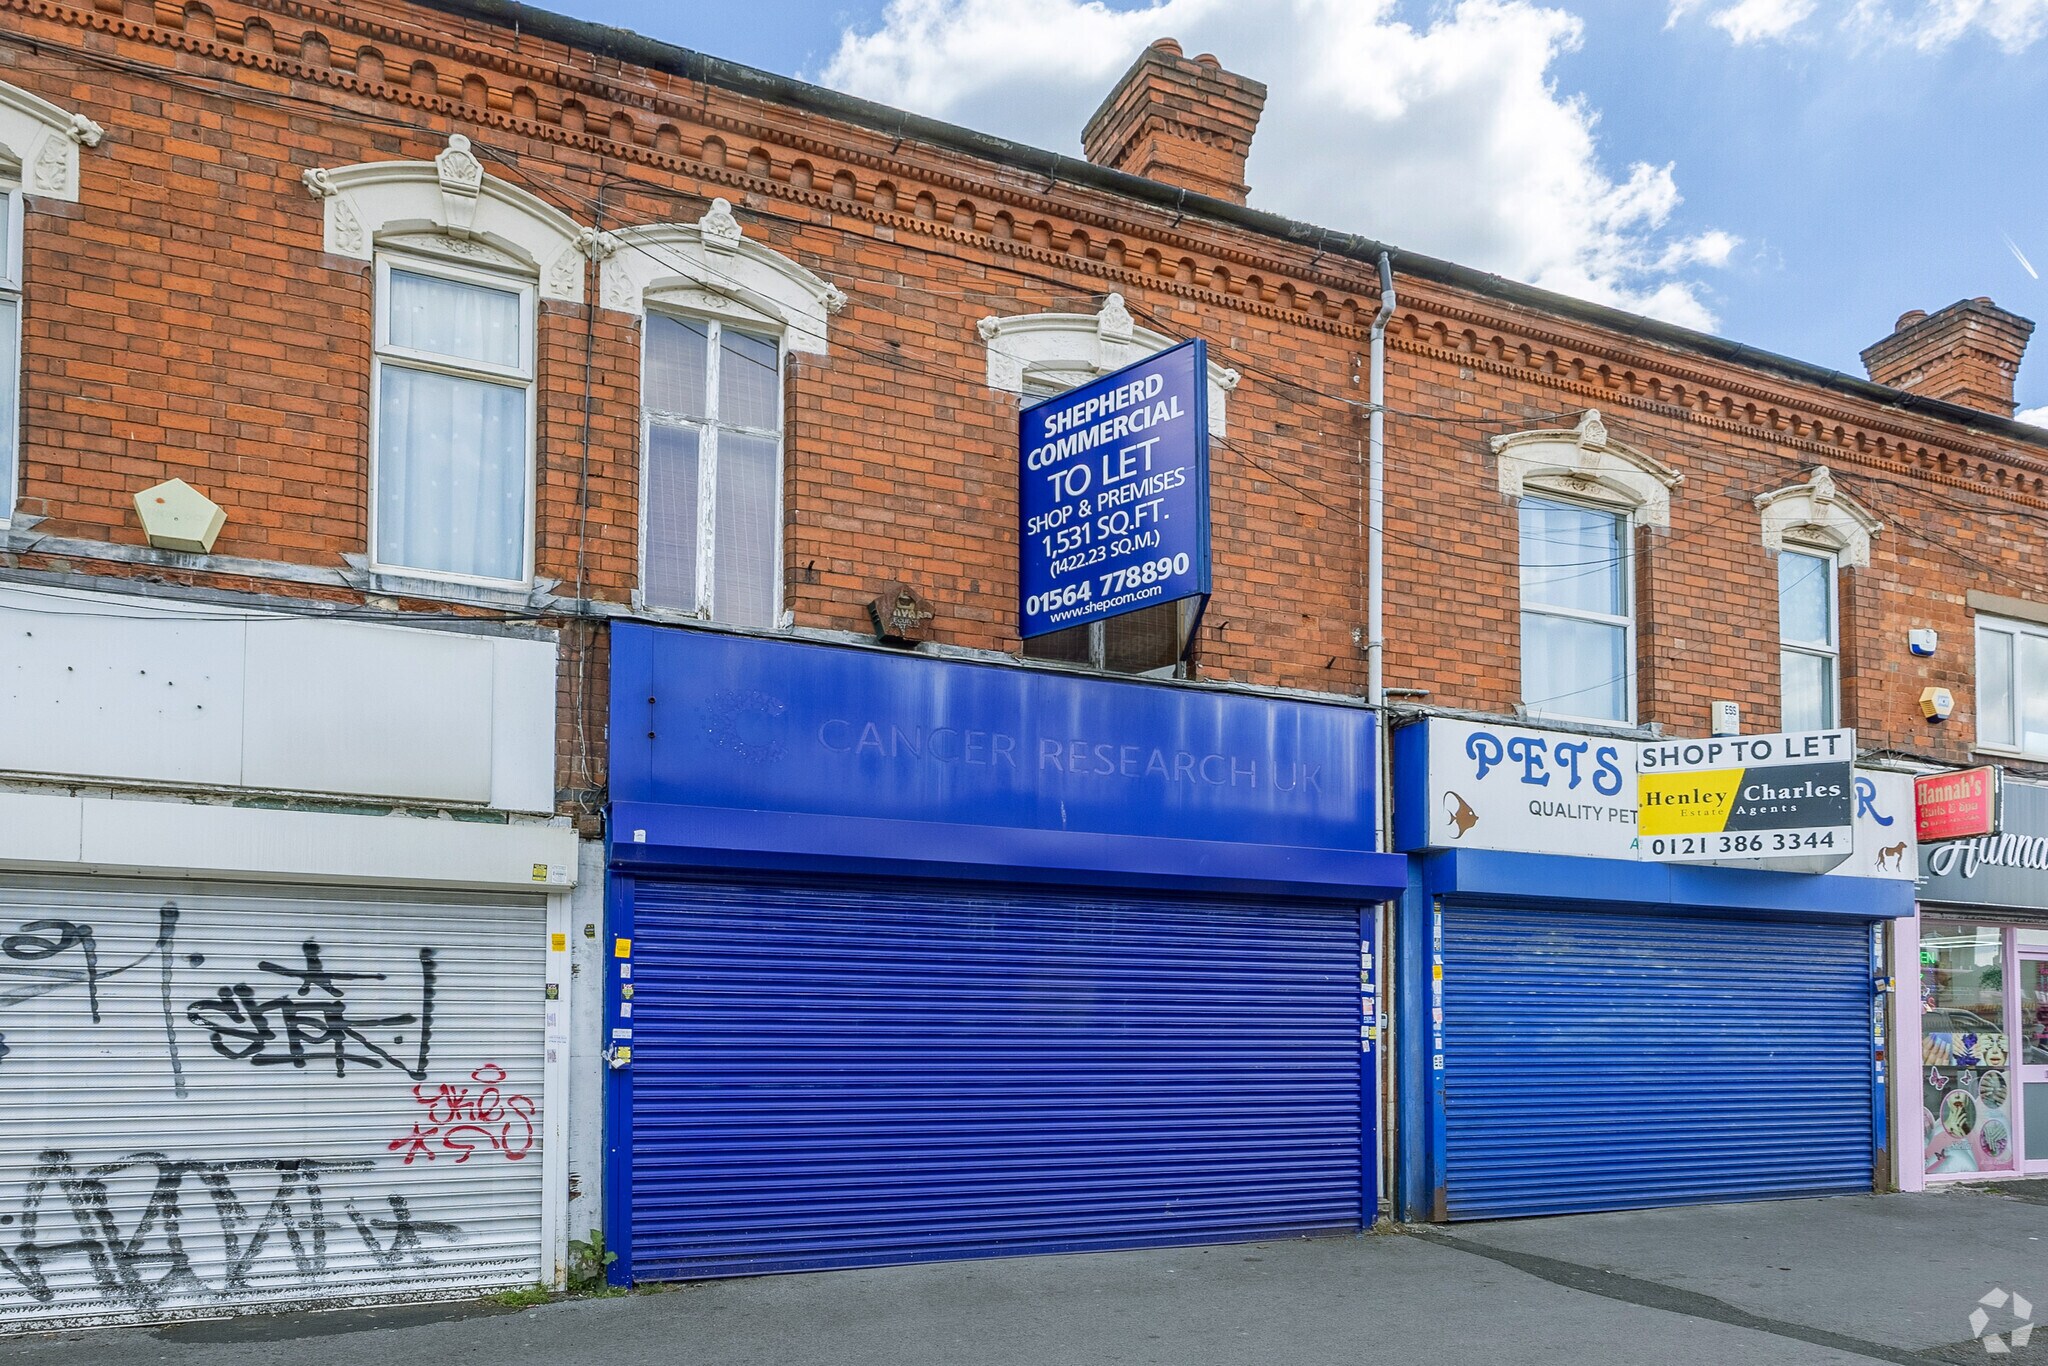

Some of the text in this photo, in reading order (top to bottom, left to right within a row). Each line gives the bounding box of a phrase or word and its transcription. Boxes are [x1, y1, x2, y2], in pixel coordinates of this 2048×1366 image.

[1044, 373, 1164, 439] SHEPHERD
[1027, 395, 1185, 471] COMMERCIAL
[1047, 436, 1161, 503] TO LET
[1027, 467, 1186, 536] SHOP & PREMISES
[1042, 497, 1170, 559] 1,531 SQ.FT.
[1050, 529, 1161, 579] (1422.23 SQ.M.)
[1026, 552, 1190, 616] 01564 778890
[1050, 585, 1162, 623] www.shepcom.com
[1725, 704, 1737, 716] ESS
[817, 718, 1322, 793] CANCER RESEARCH UK
[1465, 731, 1623, 797] PETS
[1642, 734, 1842, 768] SHOP TO LET
[1529, 799, 1603, 823] QUALITY
[1646, 781, 1842, 809] Henley Charles
[1680, 803, 1798, 817] Estate Agents
[1917, 775, 1983, 806] Hannah's
[1652, 831, 1835, 855] 0121 386 3344
